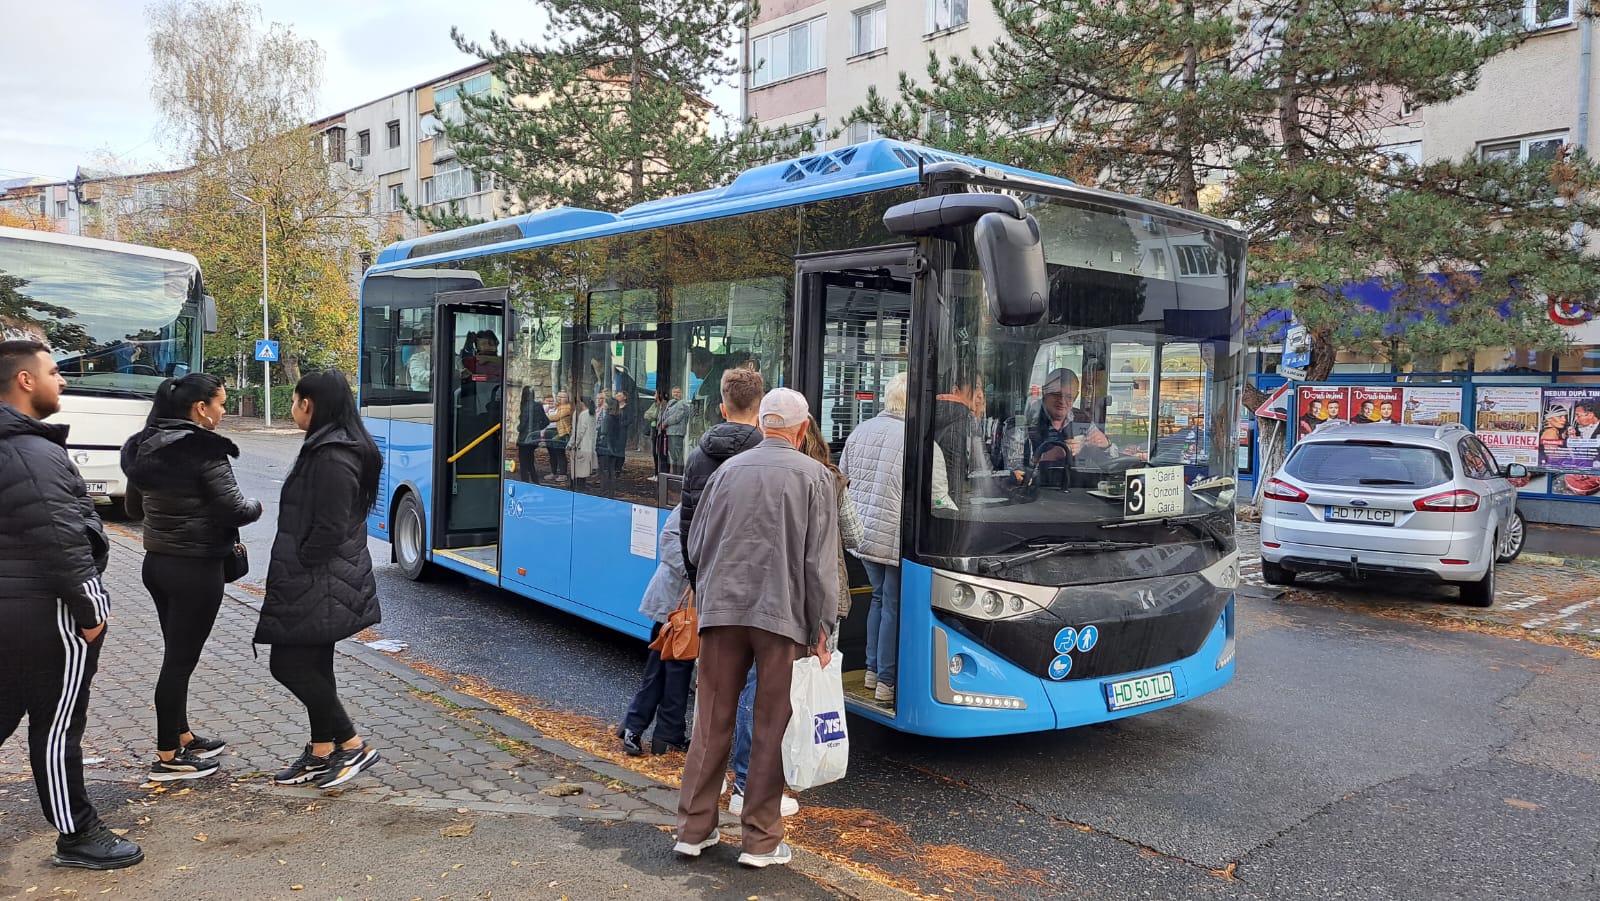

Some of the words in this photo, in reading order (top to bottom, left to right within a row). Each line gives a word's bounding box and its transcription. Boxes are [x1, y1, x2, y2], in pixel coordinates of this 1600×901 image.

[1286, 354, 1306, 365] TAXI
[1506, 435, 1538, 446] VIENEZ
[1128, 478, 1143, 512] 3
[1153, 485, 1179, 498] Orizont
[1332, 507, 1349, 518] HD
[1353, 509, 1364, 519] 17
[1367, 510, 1391, 521] LCP
[1114, 683, 1133, 703] HD
[1135, 680, 1150, 699] 50
[1150, 675, 1172, 696] TLD
